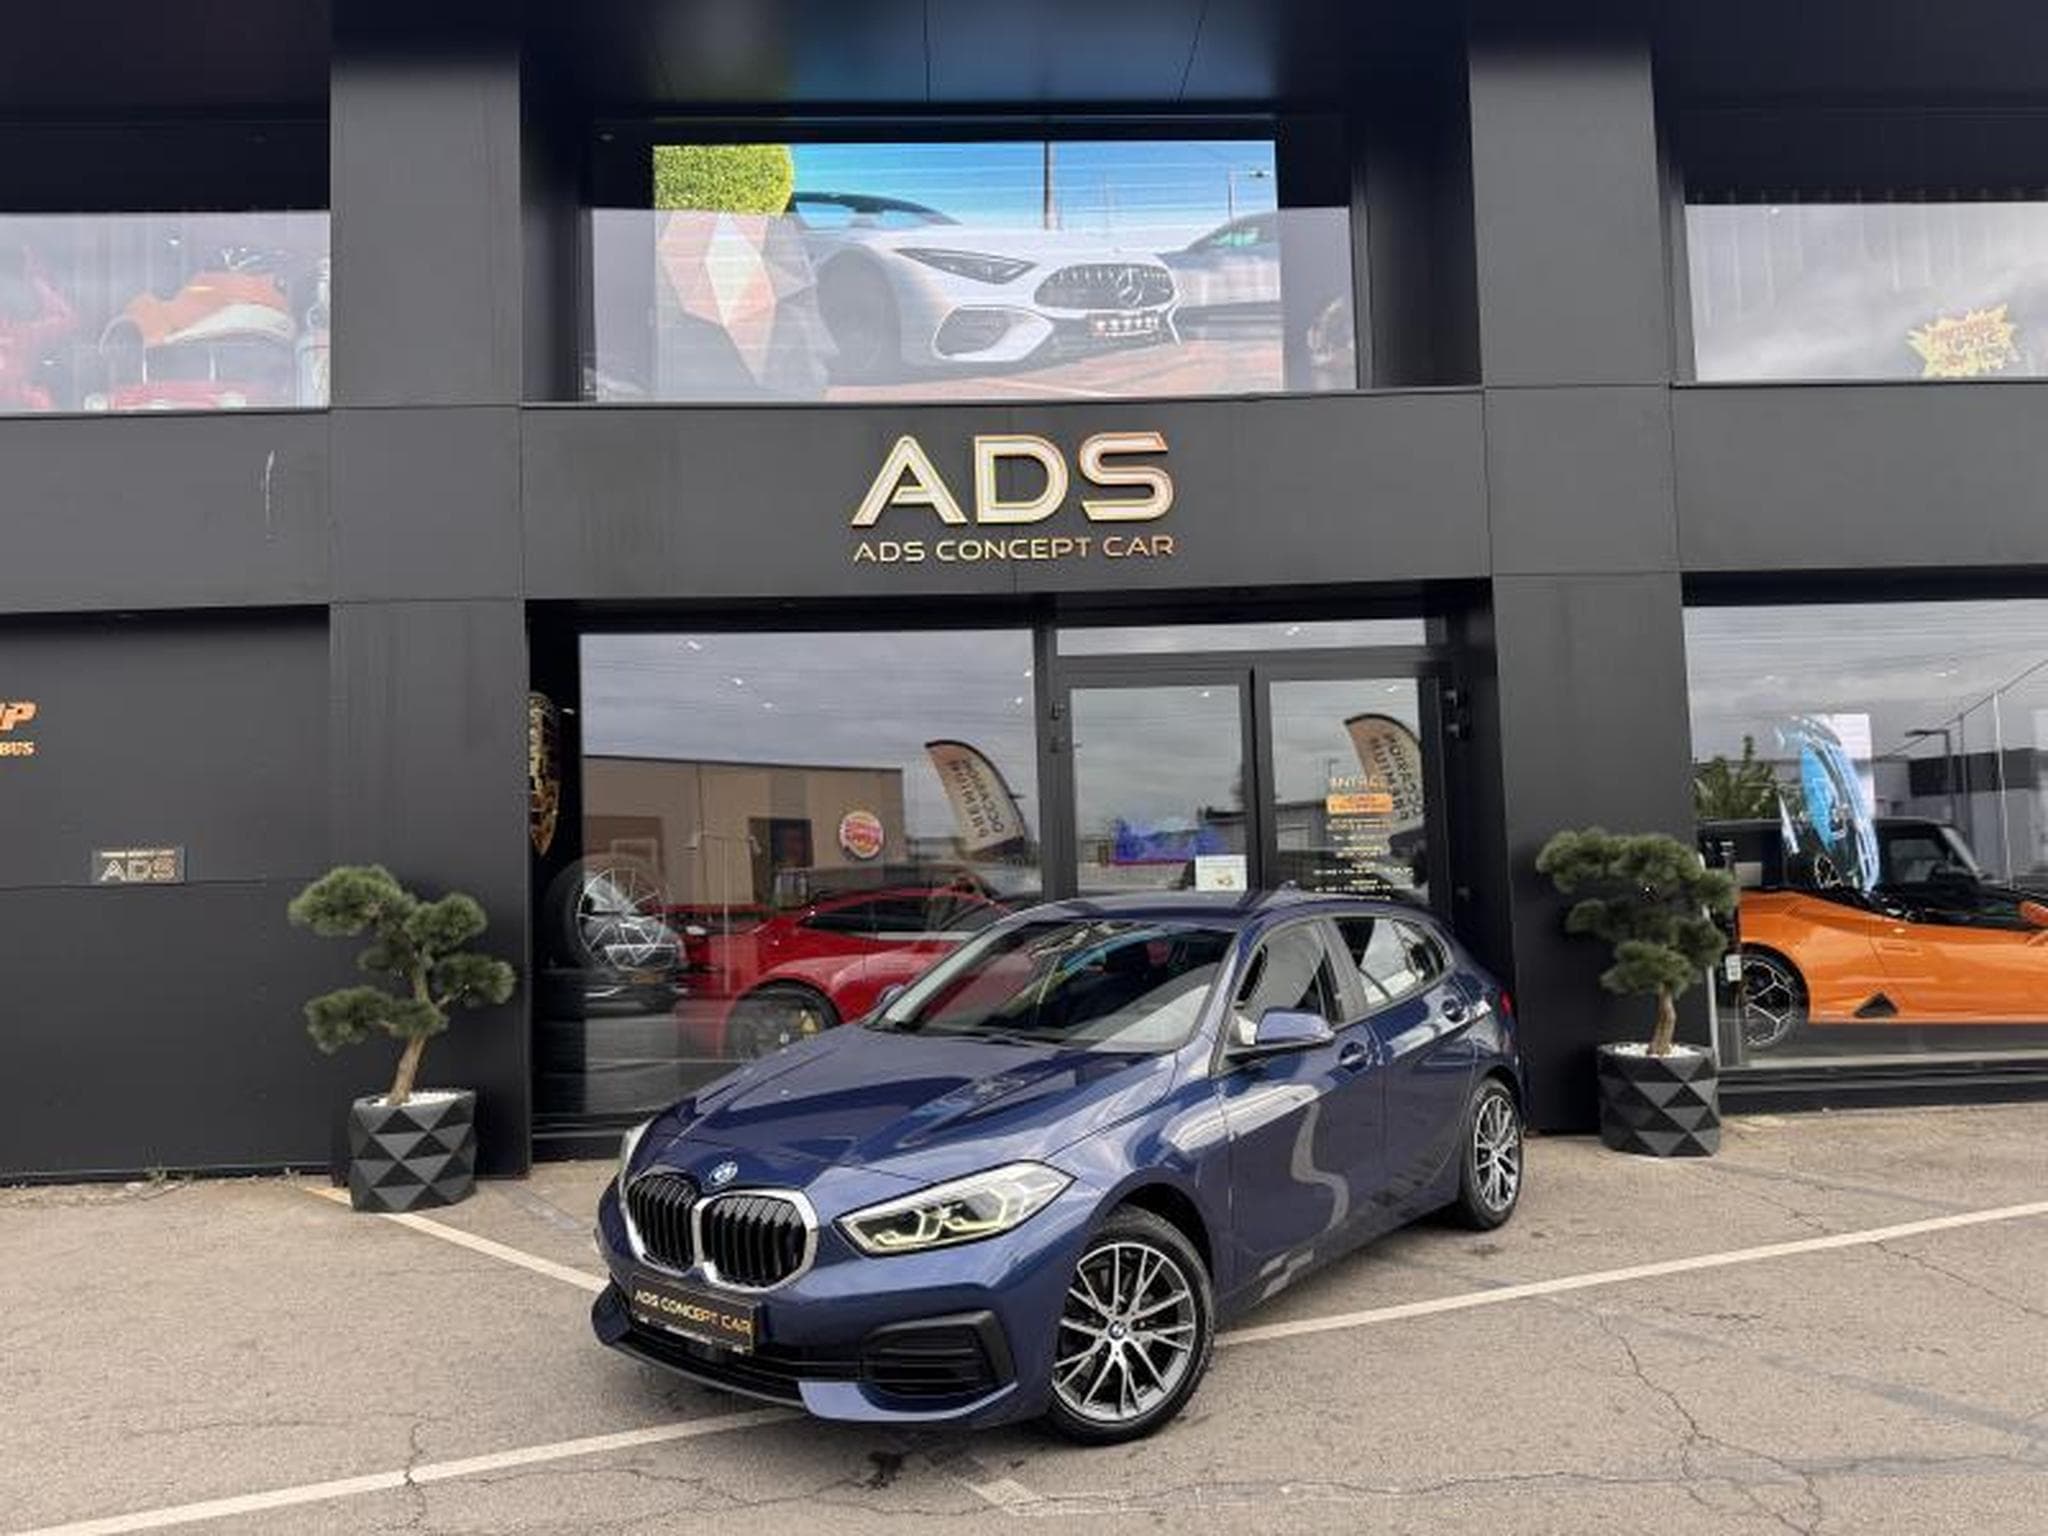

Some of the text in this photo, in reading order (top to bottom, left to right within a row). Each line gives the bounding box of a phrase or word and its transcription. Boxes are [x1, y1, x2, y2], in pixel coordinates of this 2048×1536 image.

[851, 432, 1174, 526] ADS
[853, 535, 1174, 563] ADS CONCEPT CAR
[100, 858, 176, 882] ADS
[634, 1289, 658, 1307] ADS
